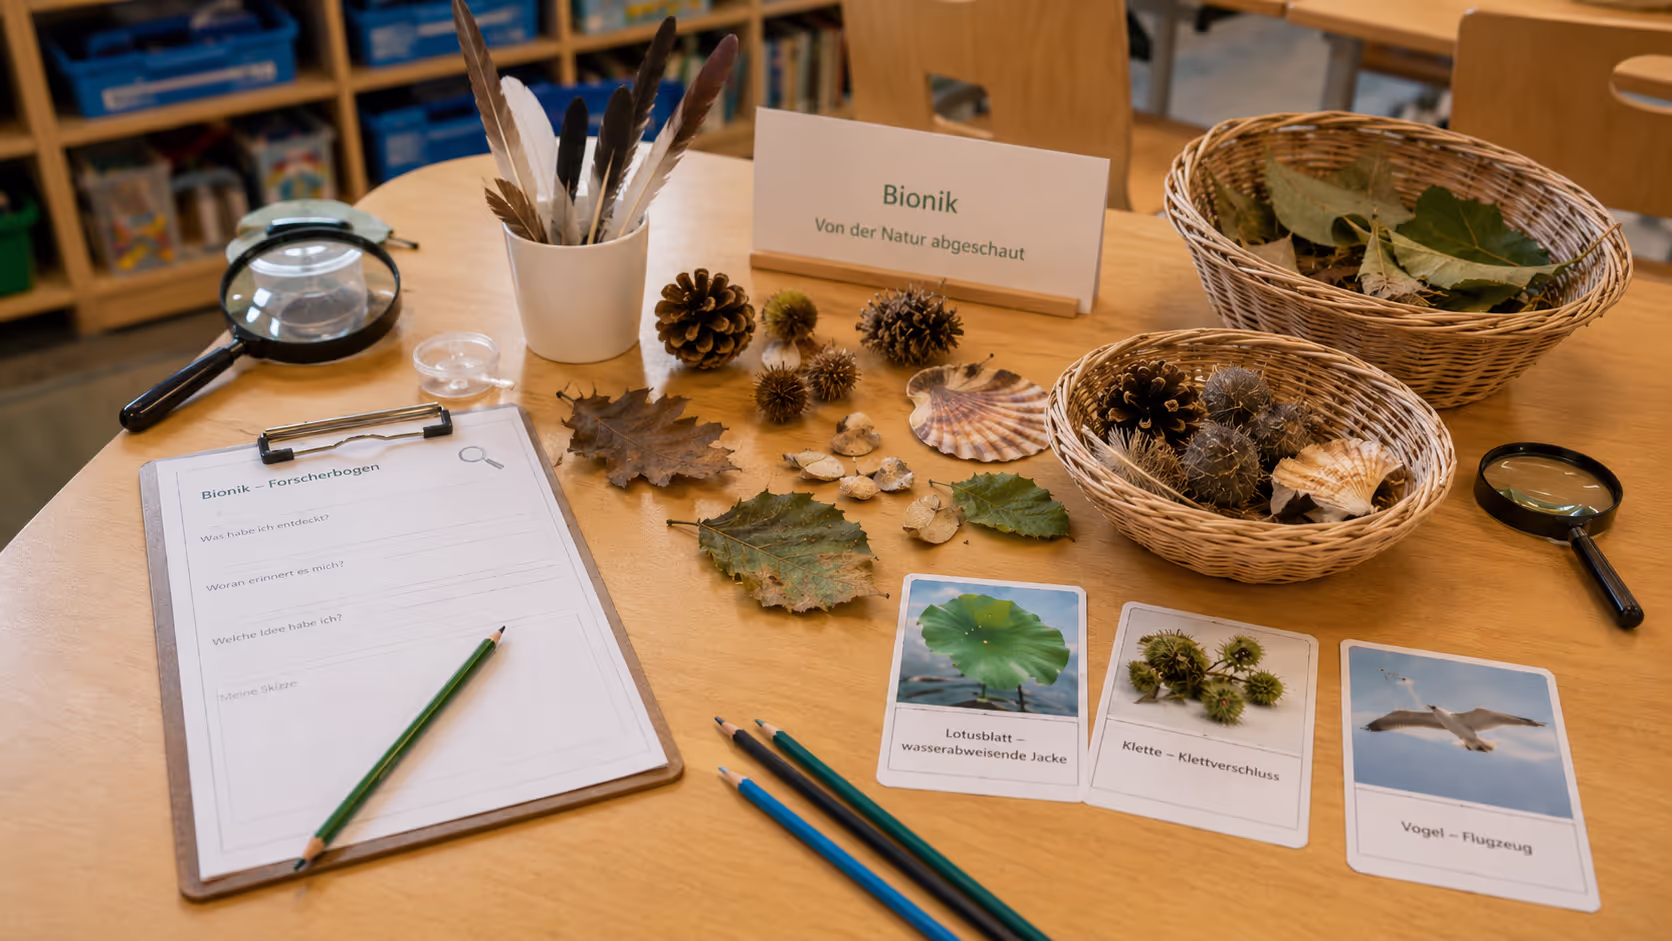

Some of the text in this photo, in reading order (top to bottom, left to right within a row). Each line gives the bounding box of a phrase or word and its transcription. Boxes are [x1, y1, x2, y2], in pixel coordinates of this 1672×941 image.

[883, 184, 959, 214] Bionik
[815, 217, 1025, 261] Von der Natur abgeschaut
[201, 484, 251, 500] Bionik
[268, 463, 381, 489] Forscherbogen
[200, 533, 225, 543] Was
[227, 527, 256, 538] habe
[257, 523, 275, 533] ich
[206, 560, 345, 592] Woran erinnert es mich?
[211, 613, 343, 646] Welche Idee habe ich?
[945, 728, 1013, 744] Lotusblatt
[901, 743, 1068, 765] wasserabweisende Jacke
[1122, 740, 1163, 758] Klette
[1178, 751, 1281, 782] Klettverschluss
[1401, 820, 1445, 839] Vogel
[1462, 831, 1534, 856] Flugzeug
